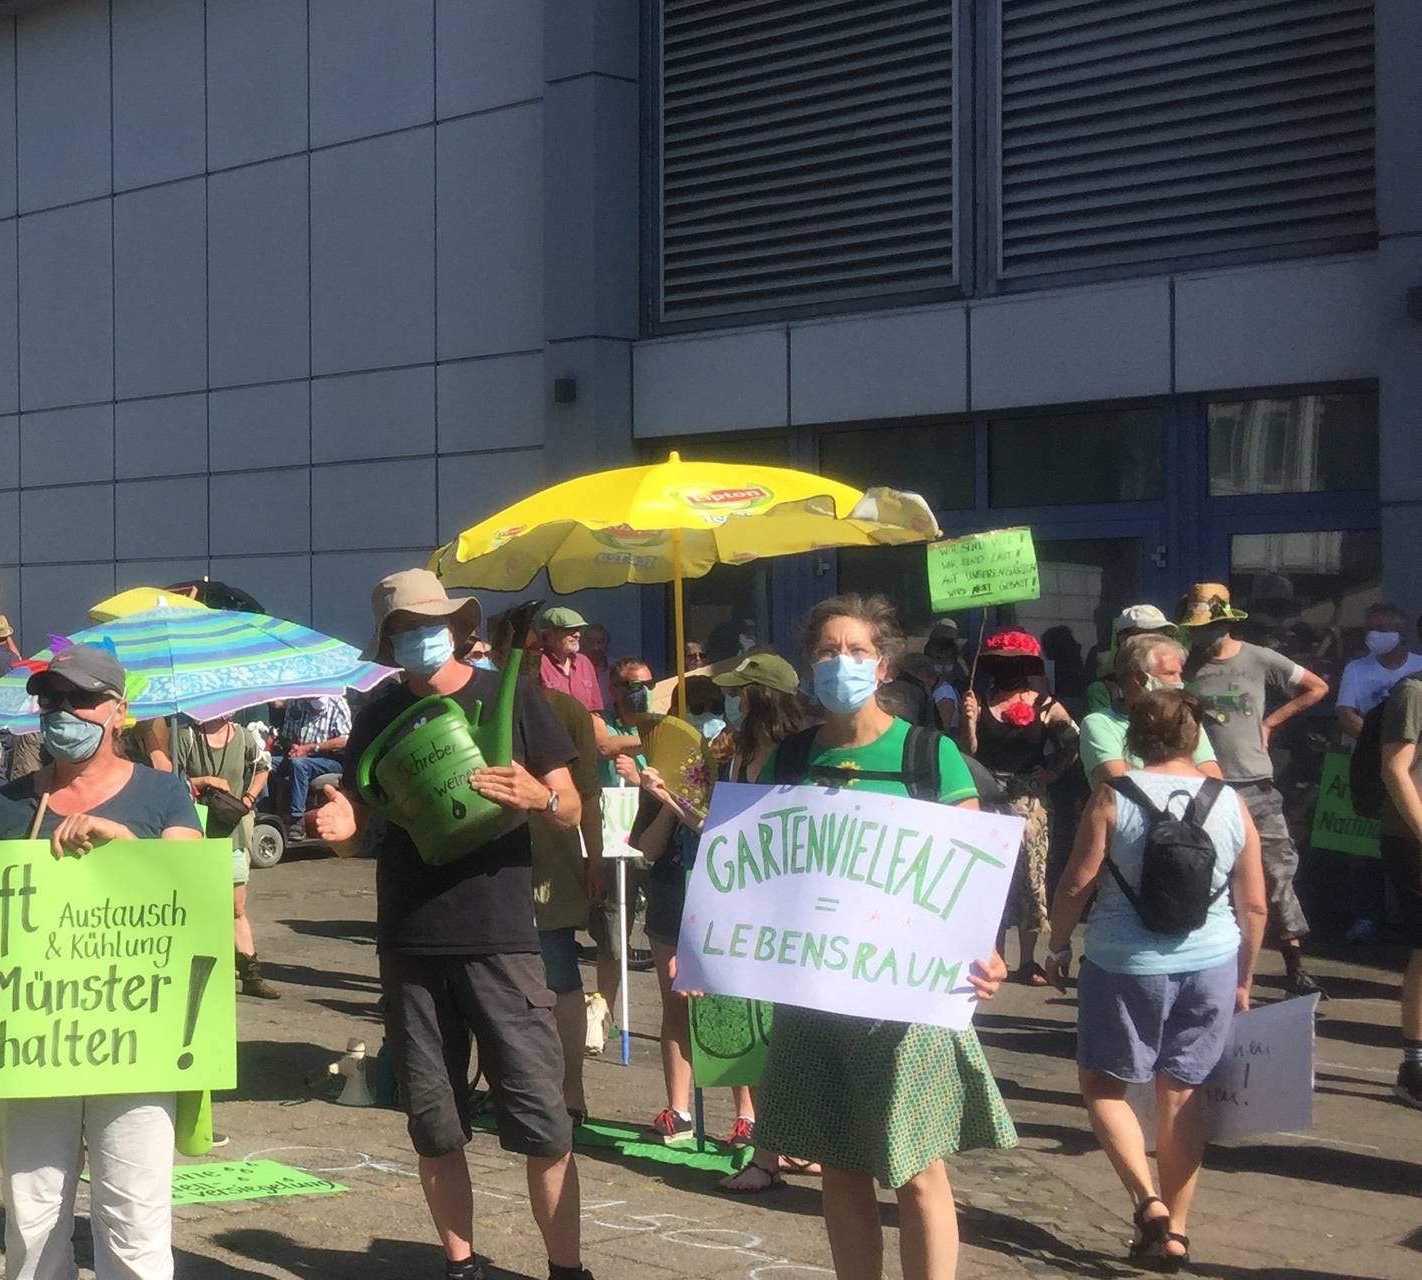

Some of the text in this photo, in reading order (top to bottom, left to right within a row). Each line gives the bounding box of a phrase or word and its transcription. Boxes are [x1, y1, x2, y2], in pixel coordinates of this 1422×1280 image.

[688, 487, 761, 505] Lipton
[706, 805, 1006, 920] GARTENVIELFALT
[58, 889, 187, 929] Austausch
[45, 931, 173, 968] & Kühlung
[702, 921, 963, 993] LEBENSRAUM
